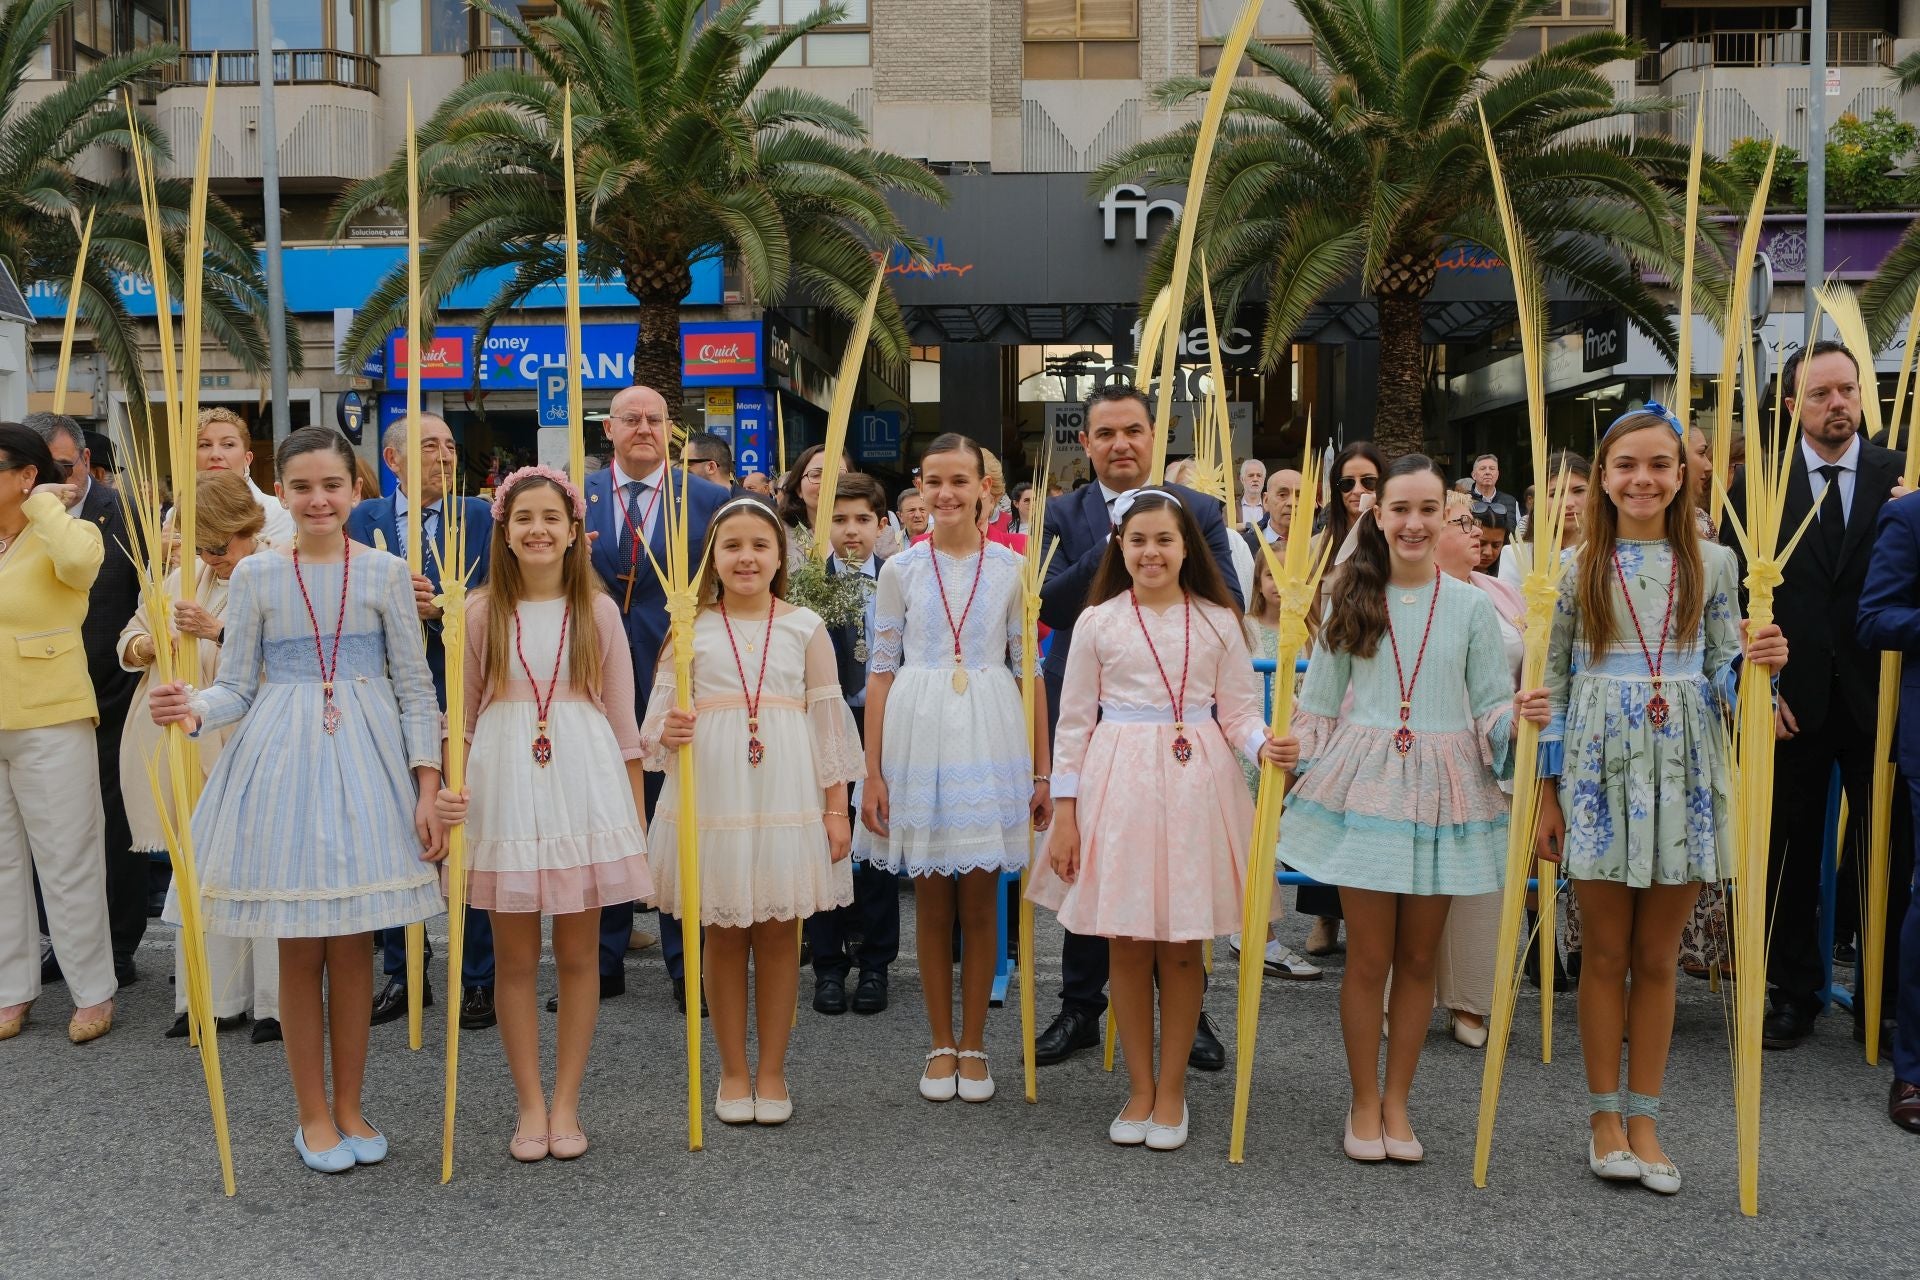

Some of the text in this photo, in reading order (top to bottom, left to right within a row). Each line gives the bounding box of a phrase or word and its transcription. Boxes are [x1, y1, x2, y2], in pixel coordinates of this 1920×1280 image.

[1099, 183, 1185, 240] fn
[771, 325, 789, 366] fnac
[1130, 318, 1252, 356] fac
[1585, 327, 1617, 361] fnac
[474, 352, 635, 381] EXCHAN
[699, 343, 741, 364] Quick
[547, 376, 566, 400] P
[390, 406, 409, 414] Mon
[736, 403, 762, 411] Money
[1055, 413, 1082, 428] NO
